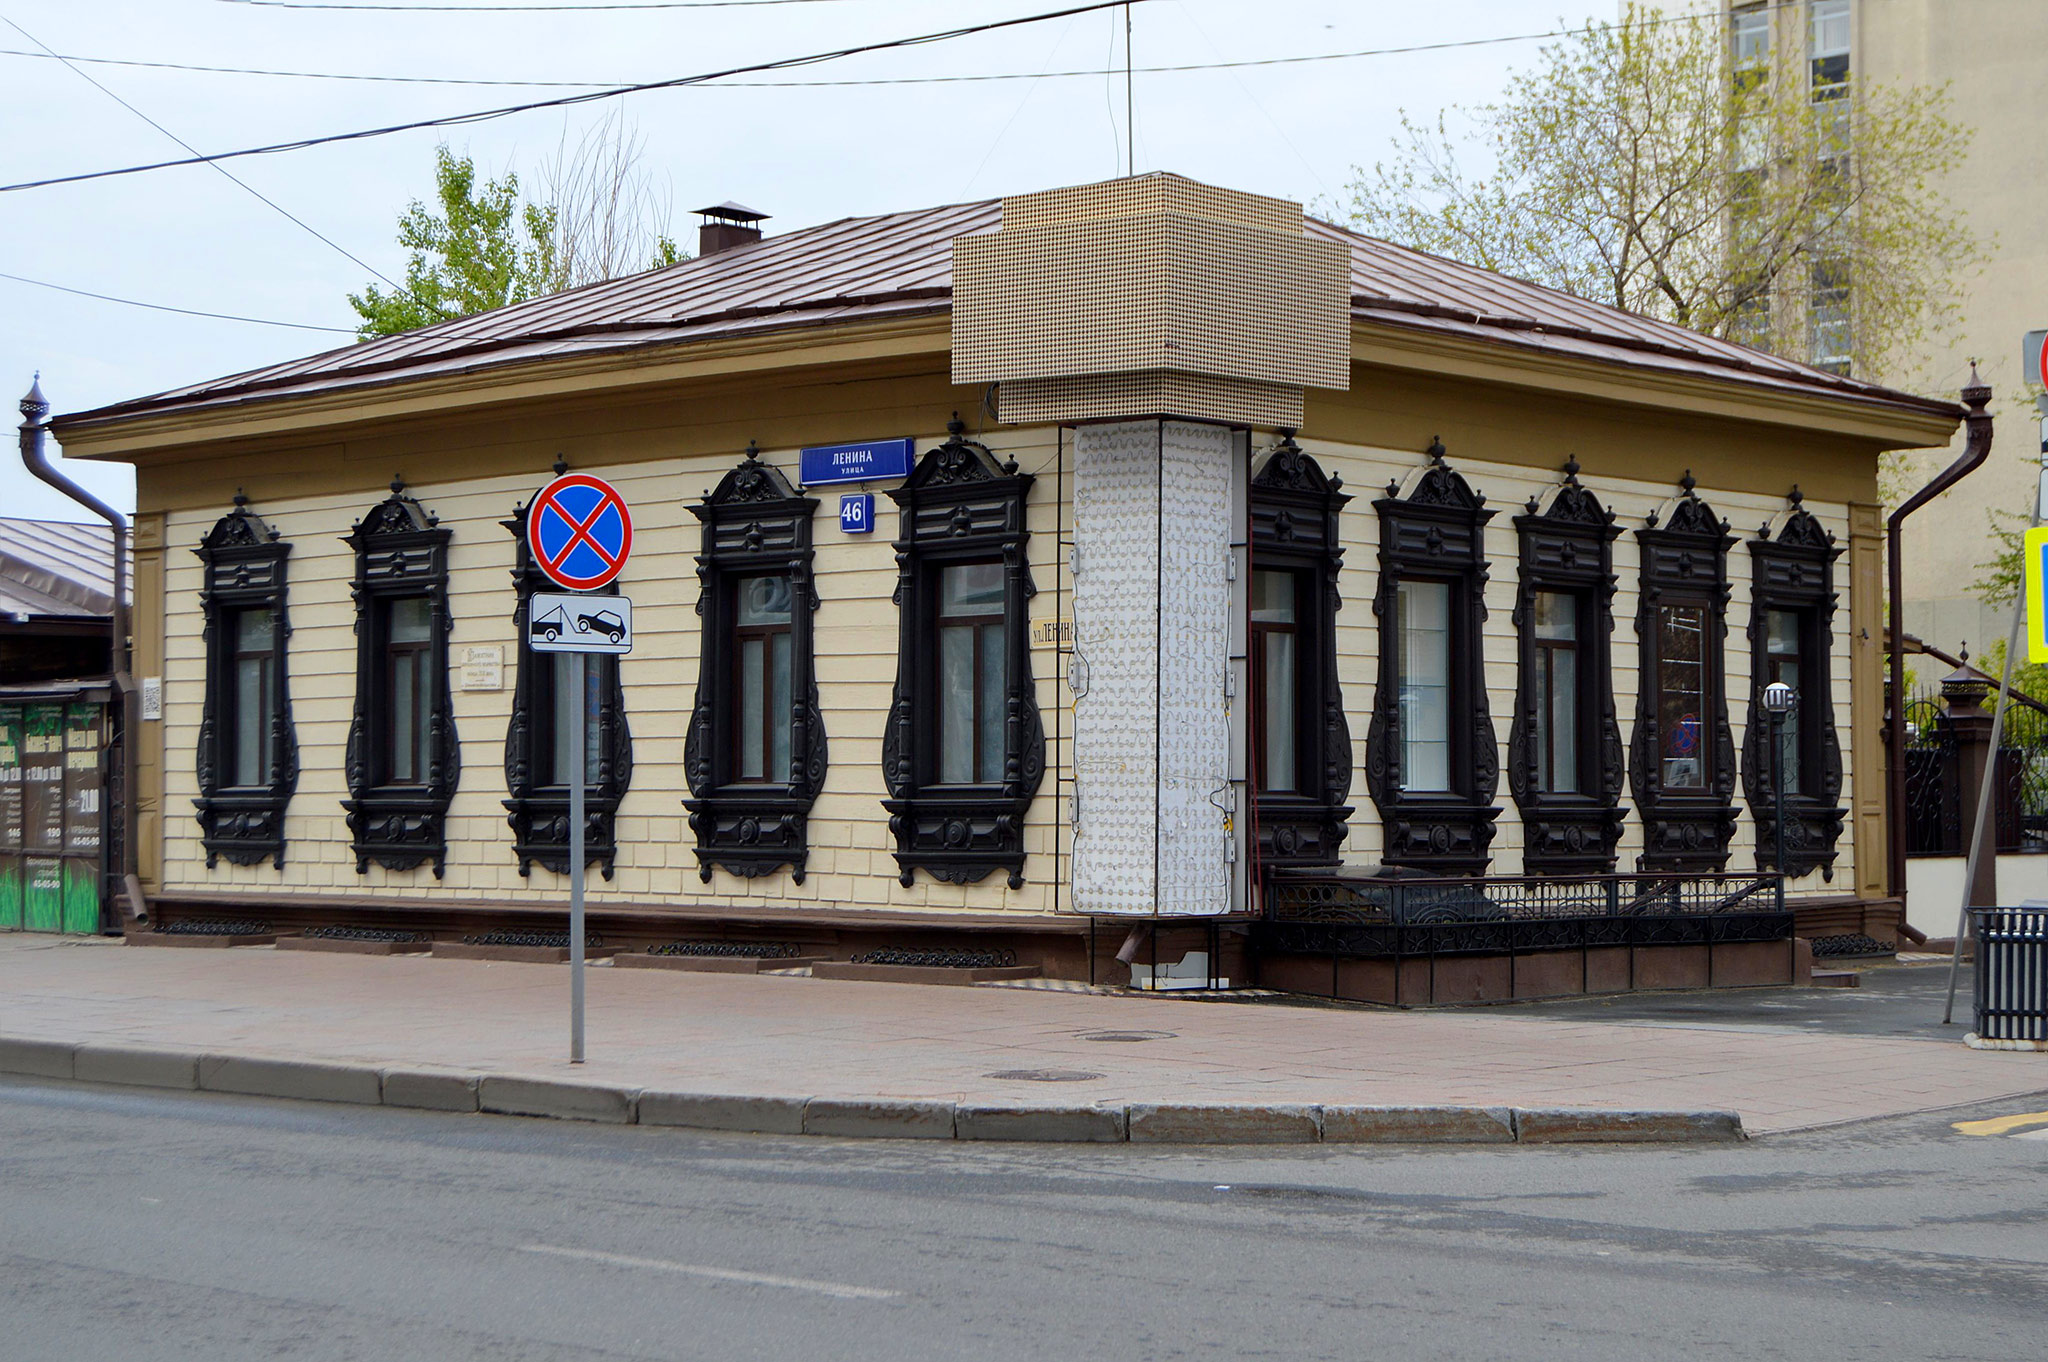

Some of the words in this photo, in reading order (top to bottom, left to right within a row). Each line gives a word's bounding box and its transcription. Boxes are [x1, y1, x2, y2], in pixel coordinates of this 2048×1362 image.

[832, 450, 873, 465] ЛЕНИНА
[841, 466, 865, 475] УЛИЦА
[842, 502, 862, 522] 46
